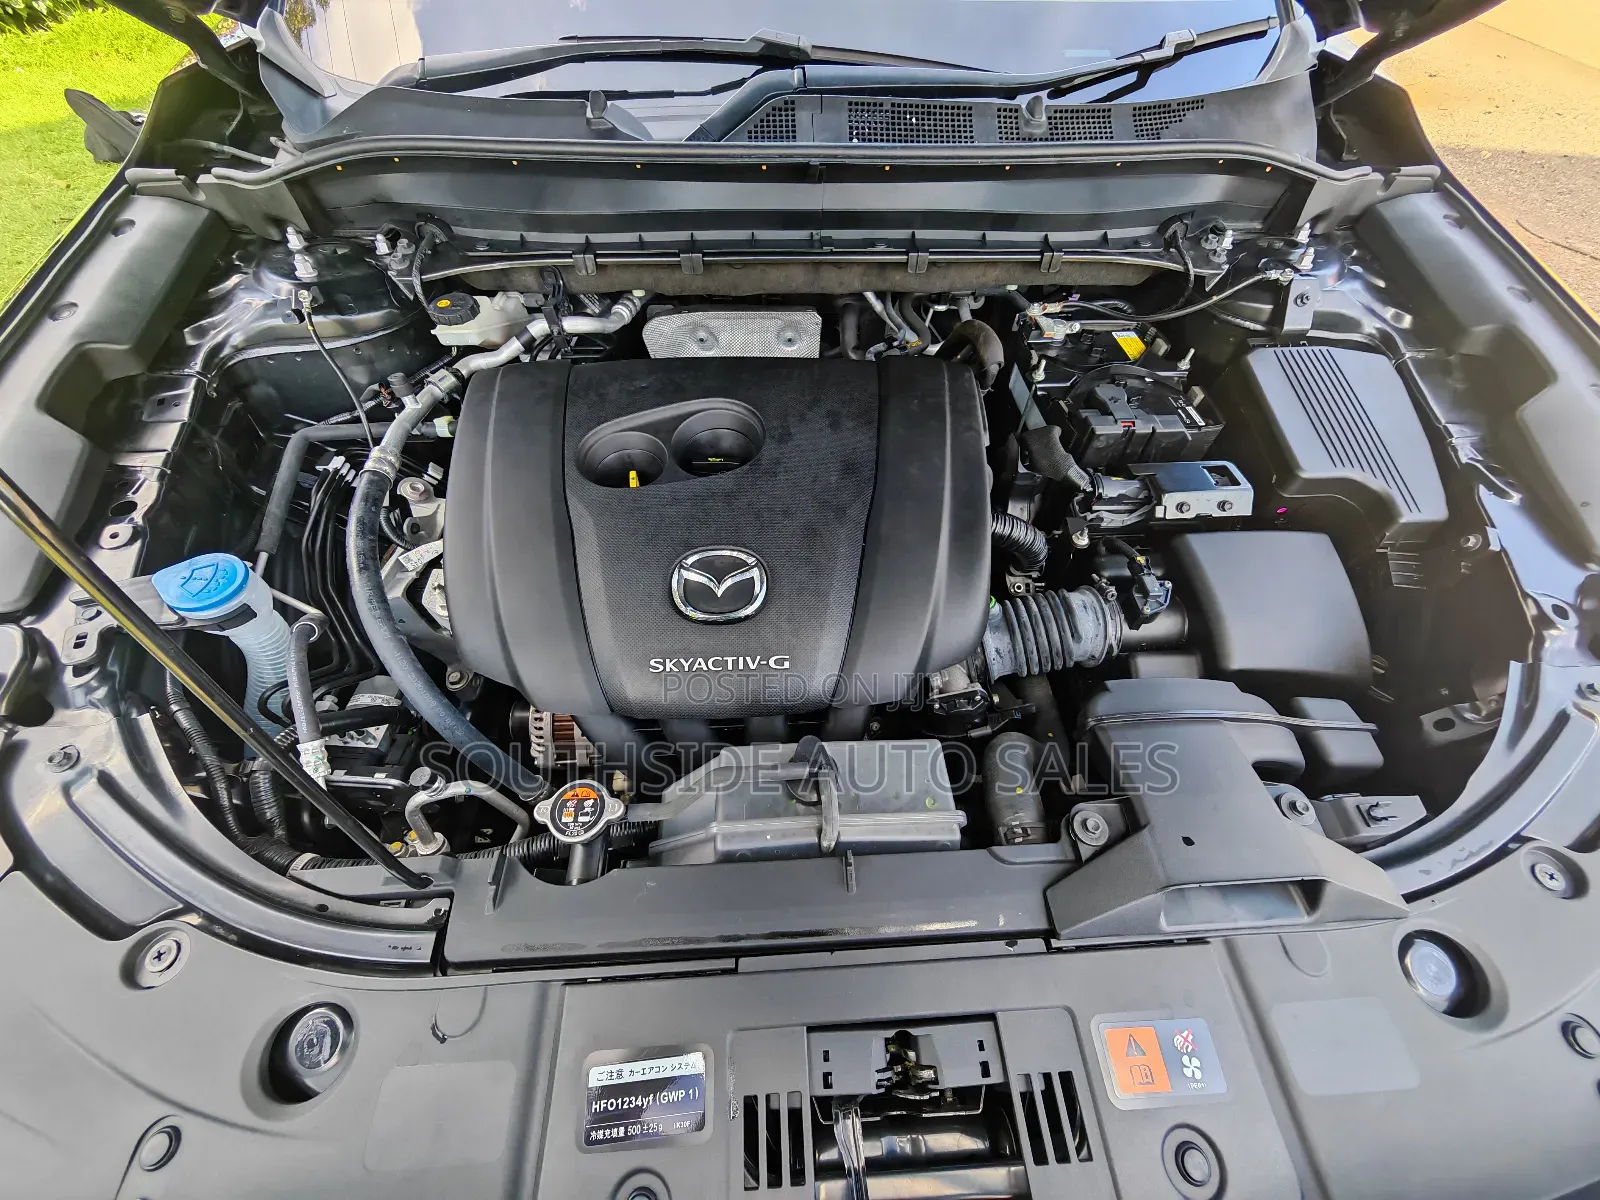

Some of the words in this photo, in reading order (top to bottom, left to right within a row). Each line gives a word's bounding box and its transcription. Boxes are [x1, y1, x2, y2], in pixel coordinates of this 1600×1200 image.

[649, 655, 790, 673] SKYACTIV-G
[597, 1068, 624, 1082] ご注意
[629, 1064, 668, 1078] カーエアコン
[591, 1093, 655, 1113] HFO1234yf
[657, 1089, 686, 1106] (GWP
[688, 1086, 699, 1101] 1)
[590, 1126, 625, 1141] 冷媒充填量
[627, 1124, 641, 1136] 500
